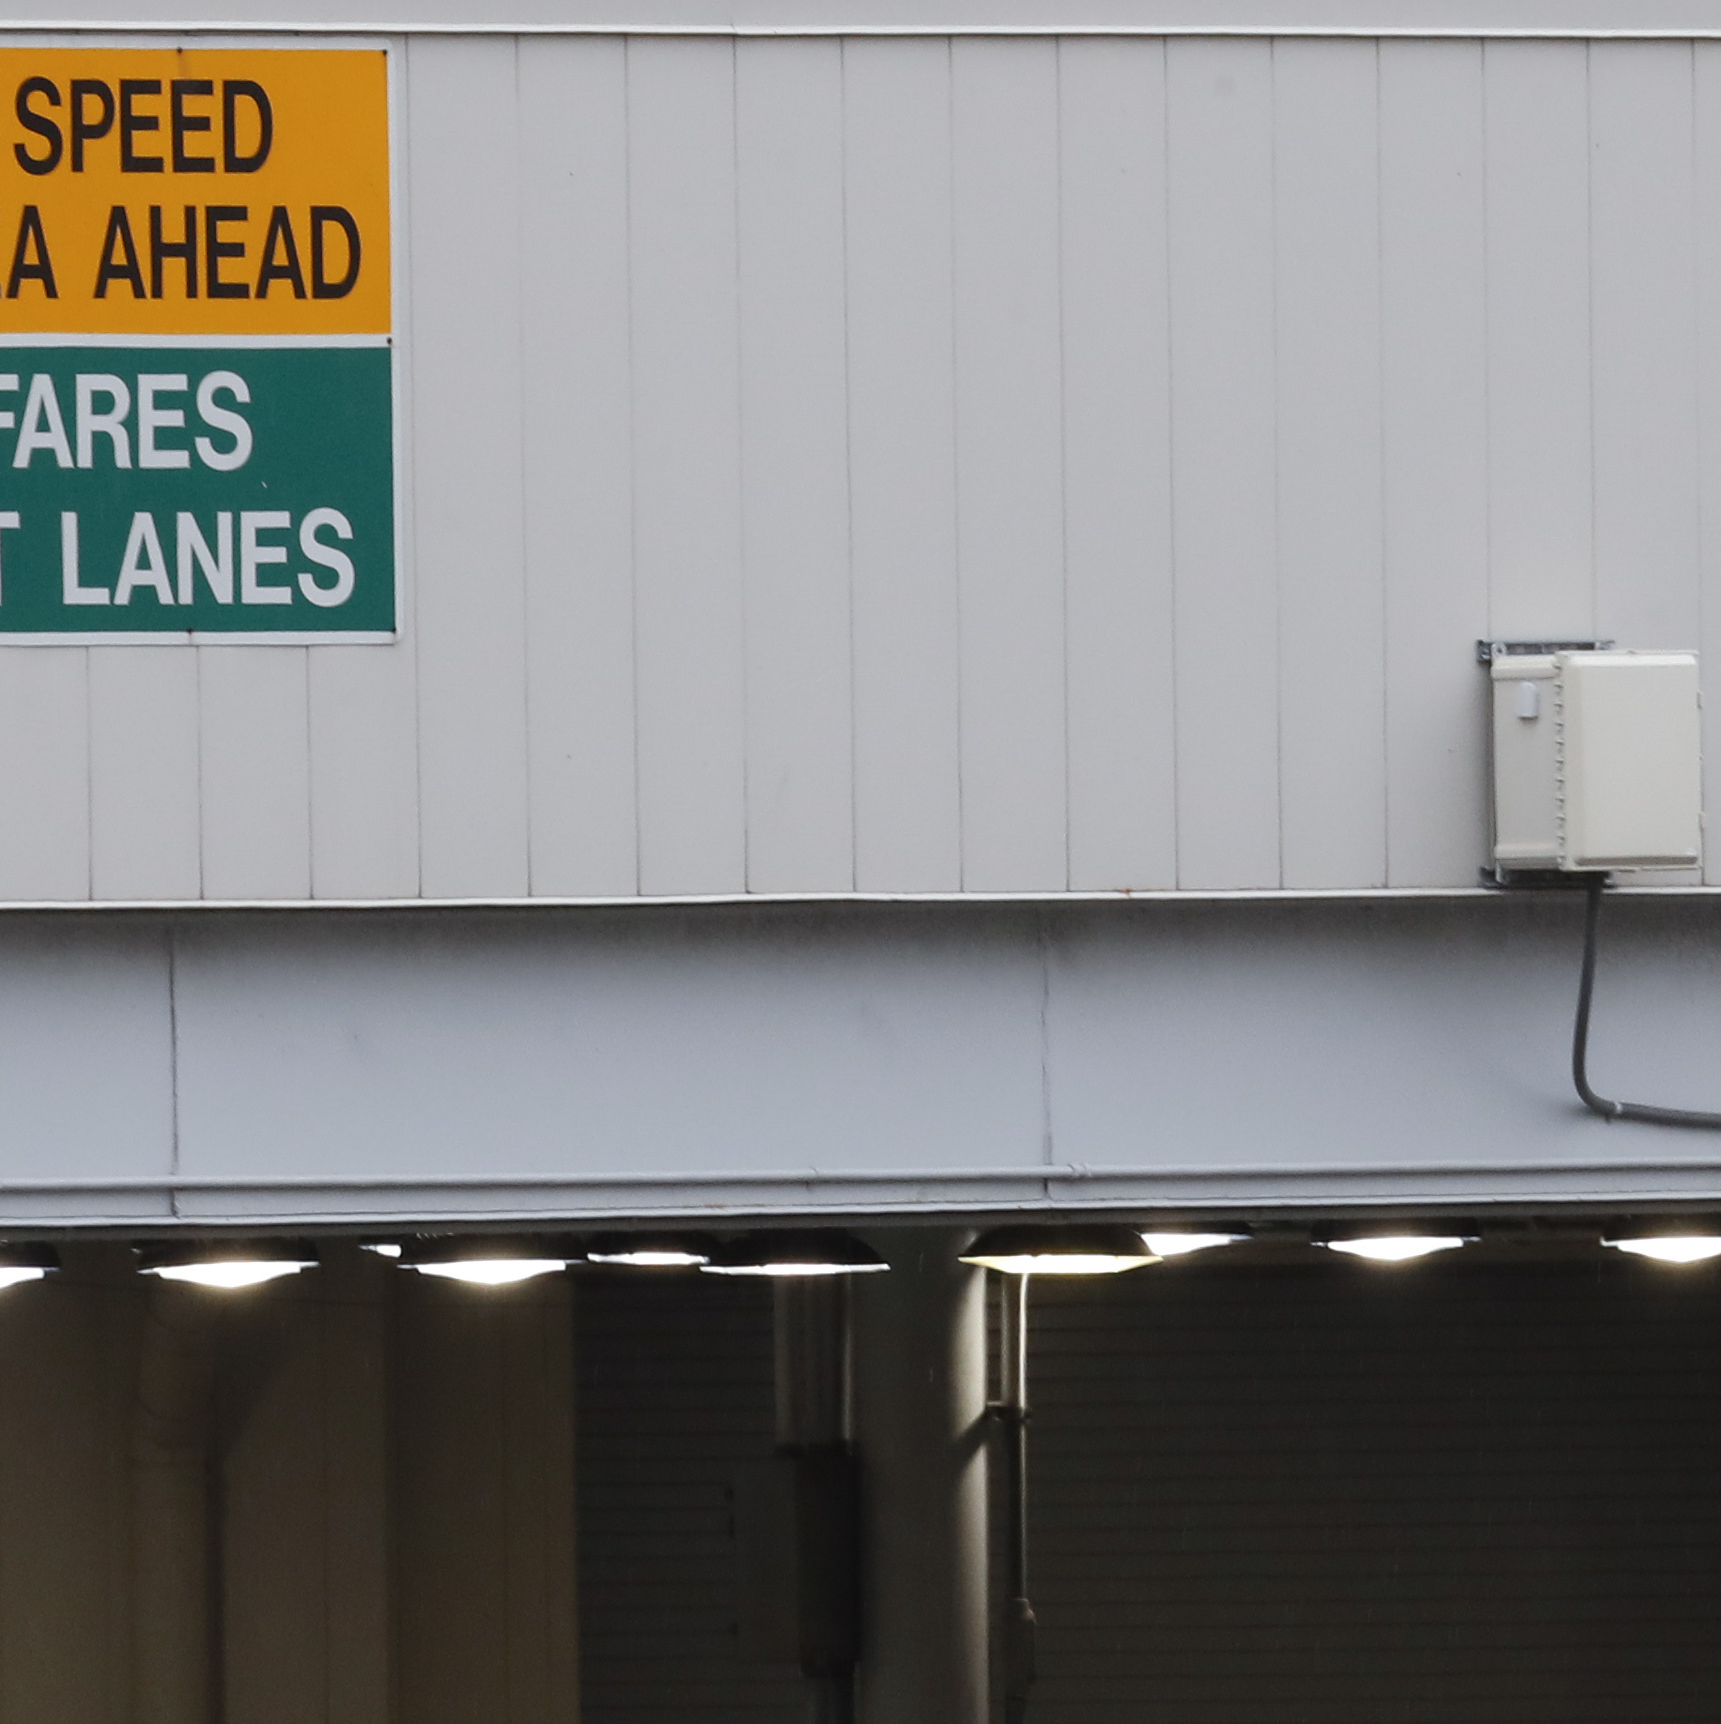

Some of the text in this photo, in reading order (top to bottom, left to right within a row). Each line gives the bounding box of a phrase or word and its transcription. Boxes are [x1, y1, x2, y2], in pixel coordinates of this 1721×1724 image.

[14, 75, 273, 176] SPEED
[94, 205, 361, 300] AHEAD
[61, 508, 355, 607] LANES
